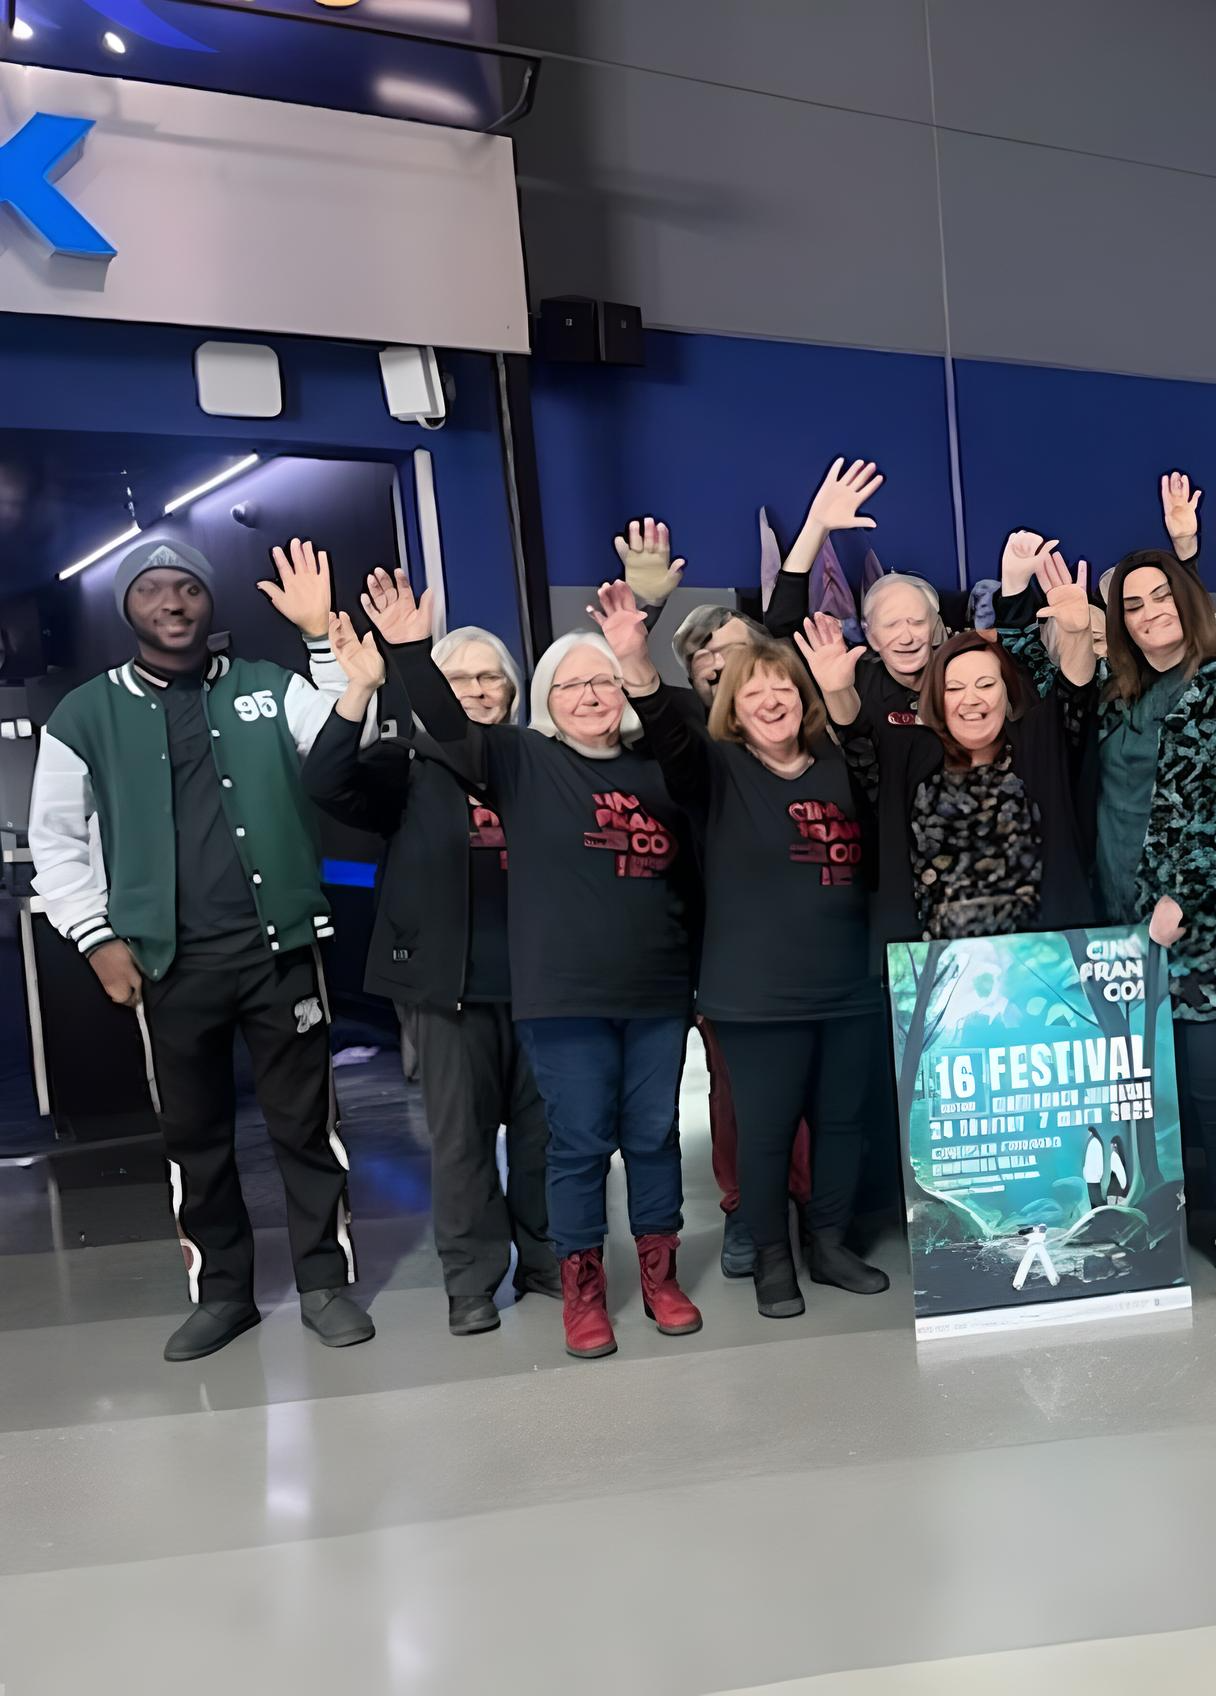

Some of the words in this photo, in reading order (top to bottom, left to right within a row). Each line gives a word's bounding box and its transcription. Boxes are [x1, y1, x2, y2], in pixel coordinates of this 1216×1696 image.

[233, 689, 278, 722] 95
[1080, 959, 1144, 983] FRAN
[935, 1055, 976, 1099] 16
[988, 1035, 1152, 1091] FESTIVAL
